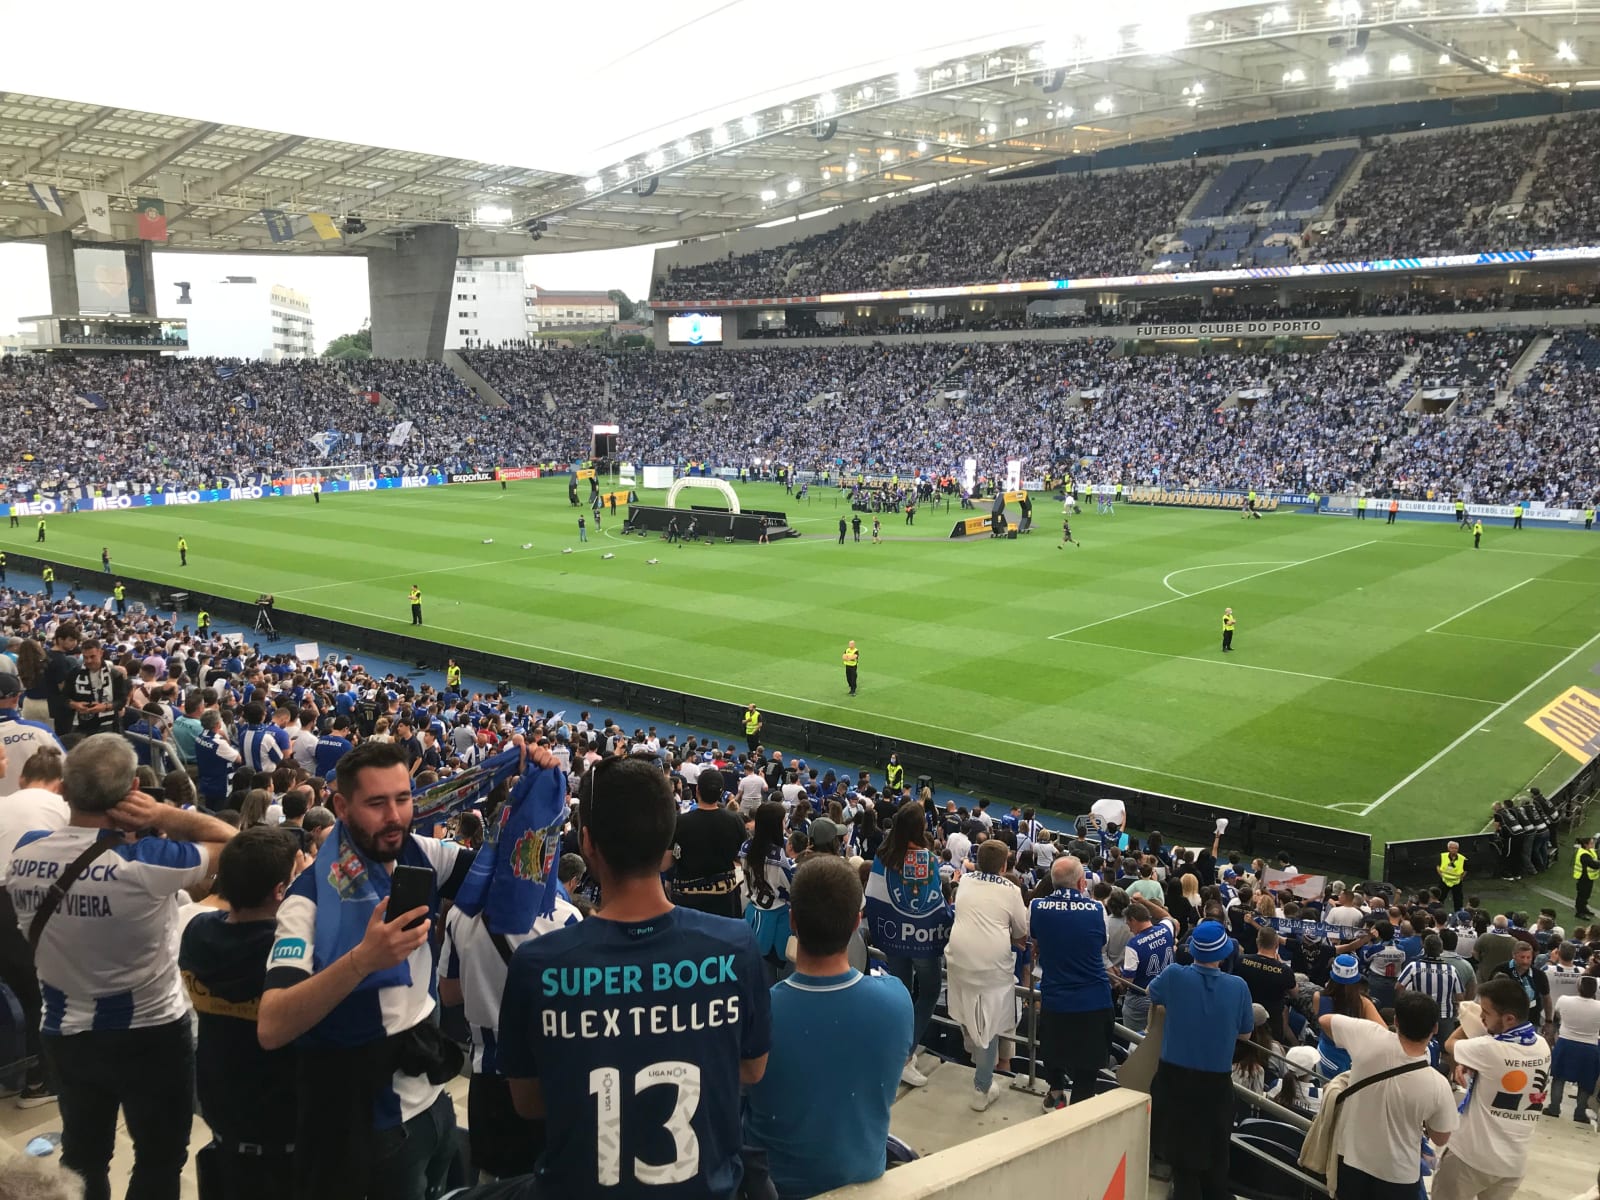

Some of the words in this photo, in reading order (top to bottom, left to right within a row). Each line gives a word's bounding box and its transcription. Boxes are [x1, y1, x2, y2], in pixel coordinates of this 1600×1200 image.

[1137, 325, 1194, 336] FUTEBOL
[1200, 323, 1242, 334] CLUBE
[1248, 322, 1267, 332] DO
[1273, 321, 1321, 332] PORTO
[349, 479, 377, 491] MEO
[402, 475, 429, 488] MEO
[165, 491, 200, 505] MEO
[231, 486, 263, 500] MEO
[15, 500, 56, 516] MEO
[93, 496, 131, 510] MEO
[3, 732, 36, 745] BOCK
[11, 858, 59, 879] SUPER
[64, 863, 119, 881] OCK
[65, 893, 112, 917] VIEIRA
[1037, 900, 1068, 910] SUPER
[1070, 902, 1098, 911] BOCK
[877, 916, 897, 939] FC
[1148, 936, 1167, 950] KITOS
[1242, 959, 1261, 969] SUPER
[1262, 963, 1282, 974] BOCK
[542, 965, 643, 997] SUPER
[652, 954, 738, 992] BOCK
[542, 1008, 621, 1038] ALEX
[629, 996, 739, 1036] TELLES
[1504, 1058, 1520, 1068] WE
[1521, 1058, 1543, 1067] NEED
[589, 1061, 701, 1186] 13
[1502, 1112, 1521, 1121] OUR
